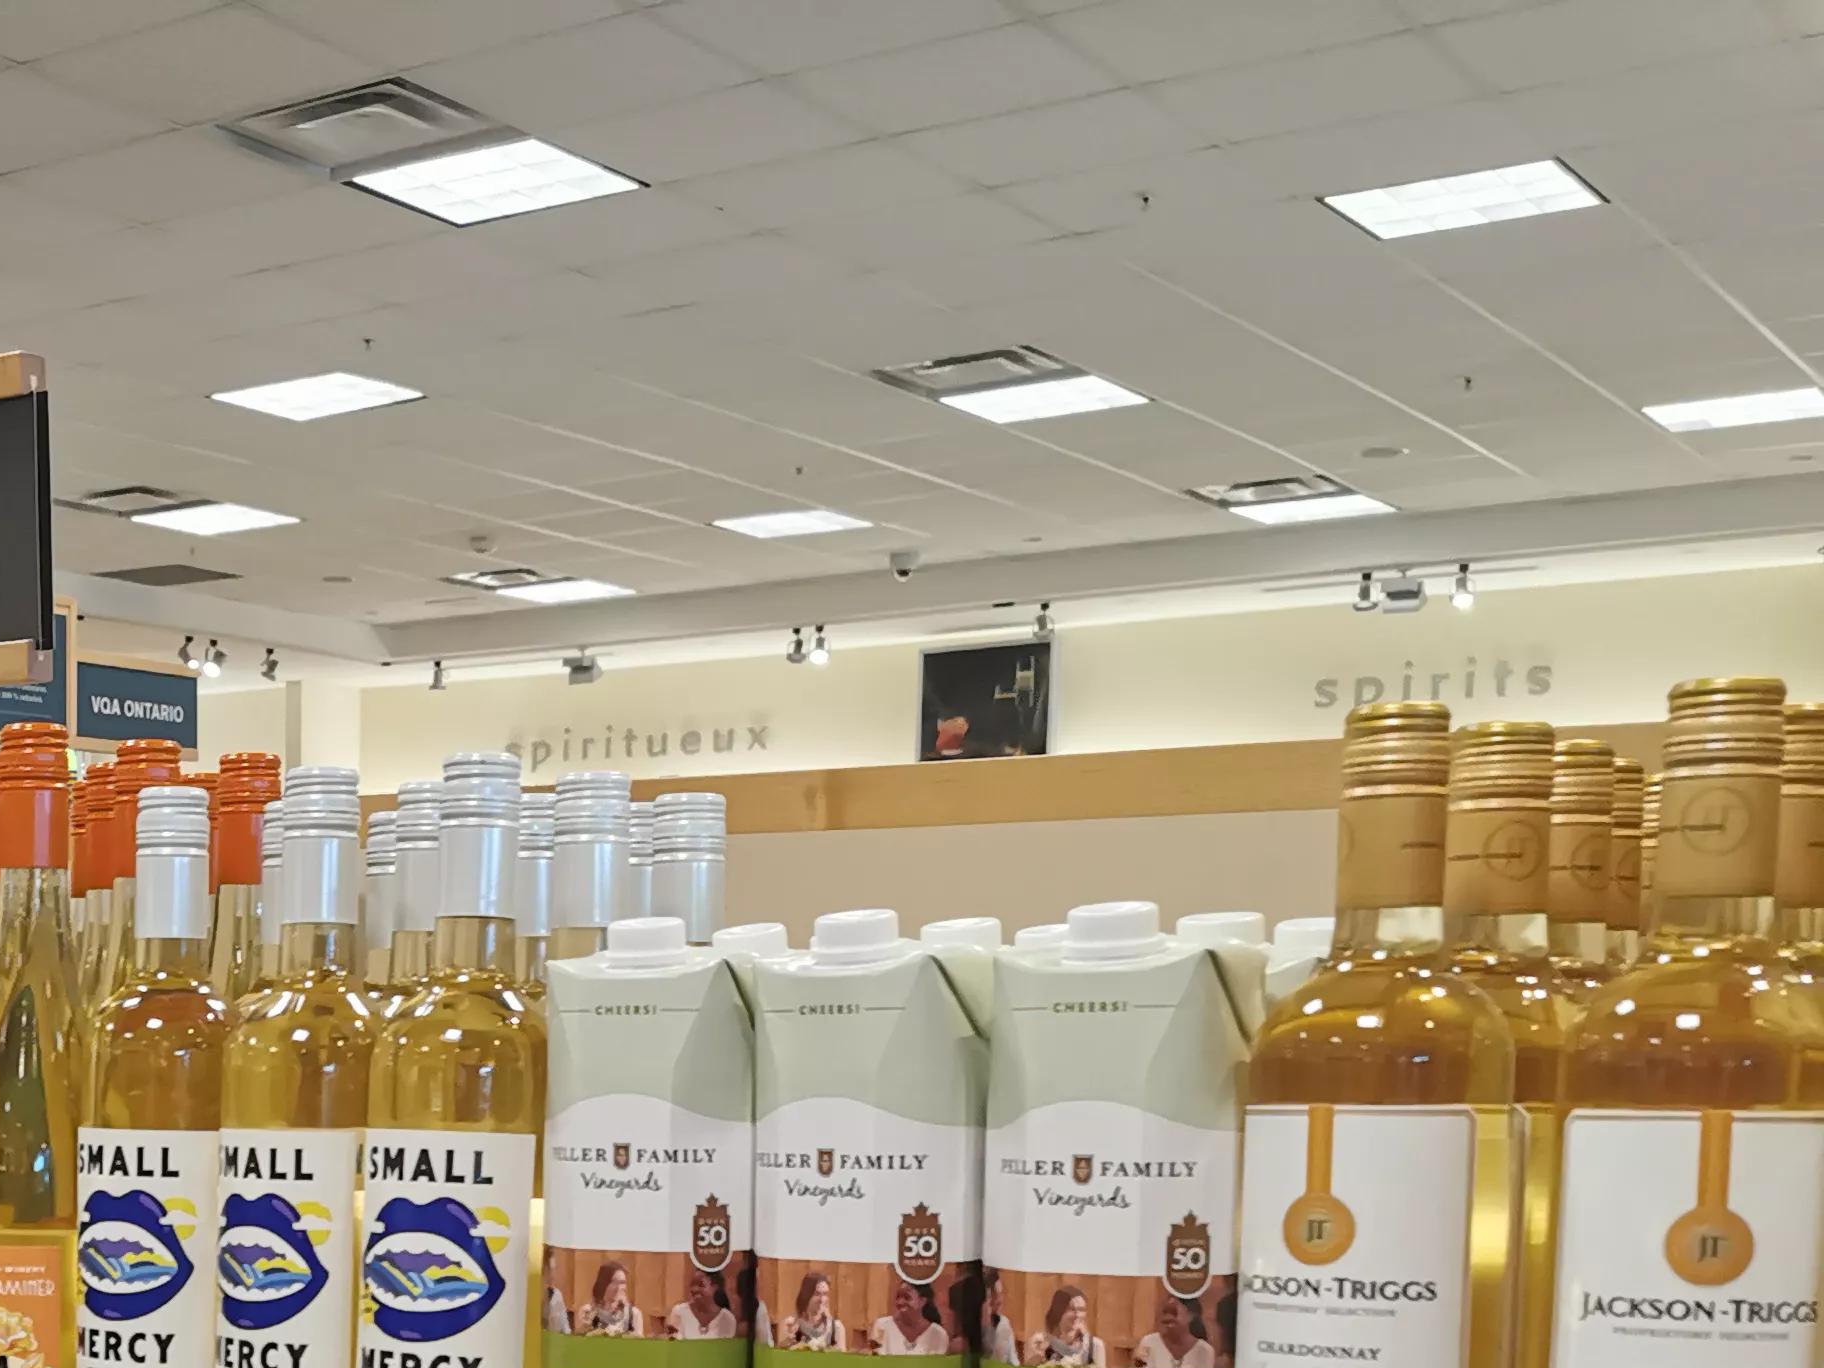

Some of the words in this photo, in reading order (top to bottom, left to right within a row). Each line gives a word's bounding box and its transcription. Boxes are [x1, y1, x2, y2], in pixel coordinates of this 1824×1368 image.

[1314, 659, 1553, 710] spirits
[90, 695, 121, 716] VQA
[125, 700, 184, 723] ONTARIO
[504, 722, 772, 773] spiritueux
[594, 1003, 658, 1016] CHEERS!
[798, 1003, 861, 1015] CHEERS!
[1053, 1001, 1129, 1014] CHEERS!
[78, 1143, 180, 1178] SMALL
[369, 1146, 494, 1185] SMALL
[636, 1147, 717, 1165] FAMILY
[840, 1153, 929, 1170] FAMILY
[1000, 1158, 1065, 1176] PELLER
[1100, 1160, 1199, 1178] FAMILY
[580, 1170, 663, 1198] Vineyards
[784, 1177, 866, 1206] Vineyards
[1033, 1187, 1131, 1216] Vineyards
[697, 1226, 726, 1246] 50
[904, 1235, 937, 1258] 50
[1172, 1246, 1206, 1270] 50
[1578, 1291, 1818, 1324] JACKSON-TRIGGS
[1257, 1341, 1381, 1362] CHARDONNAY
